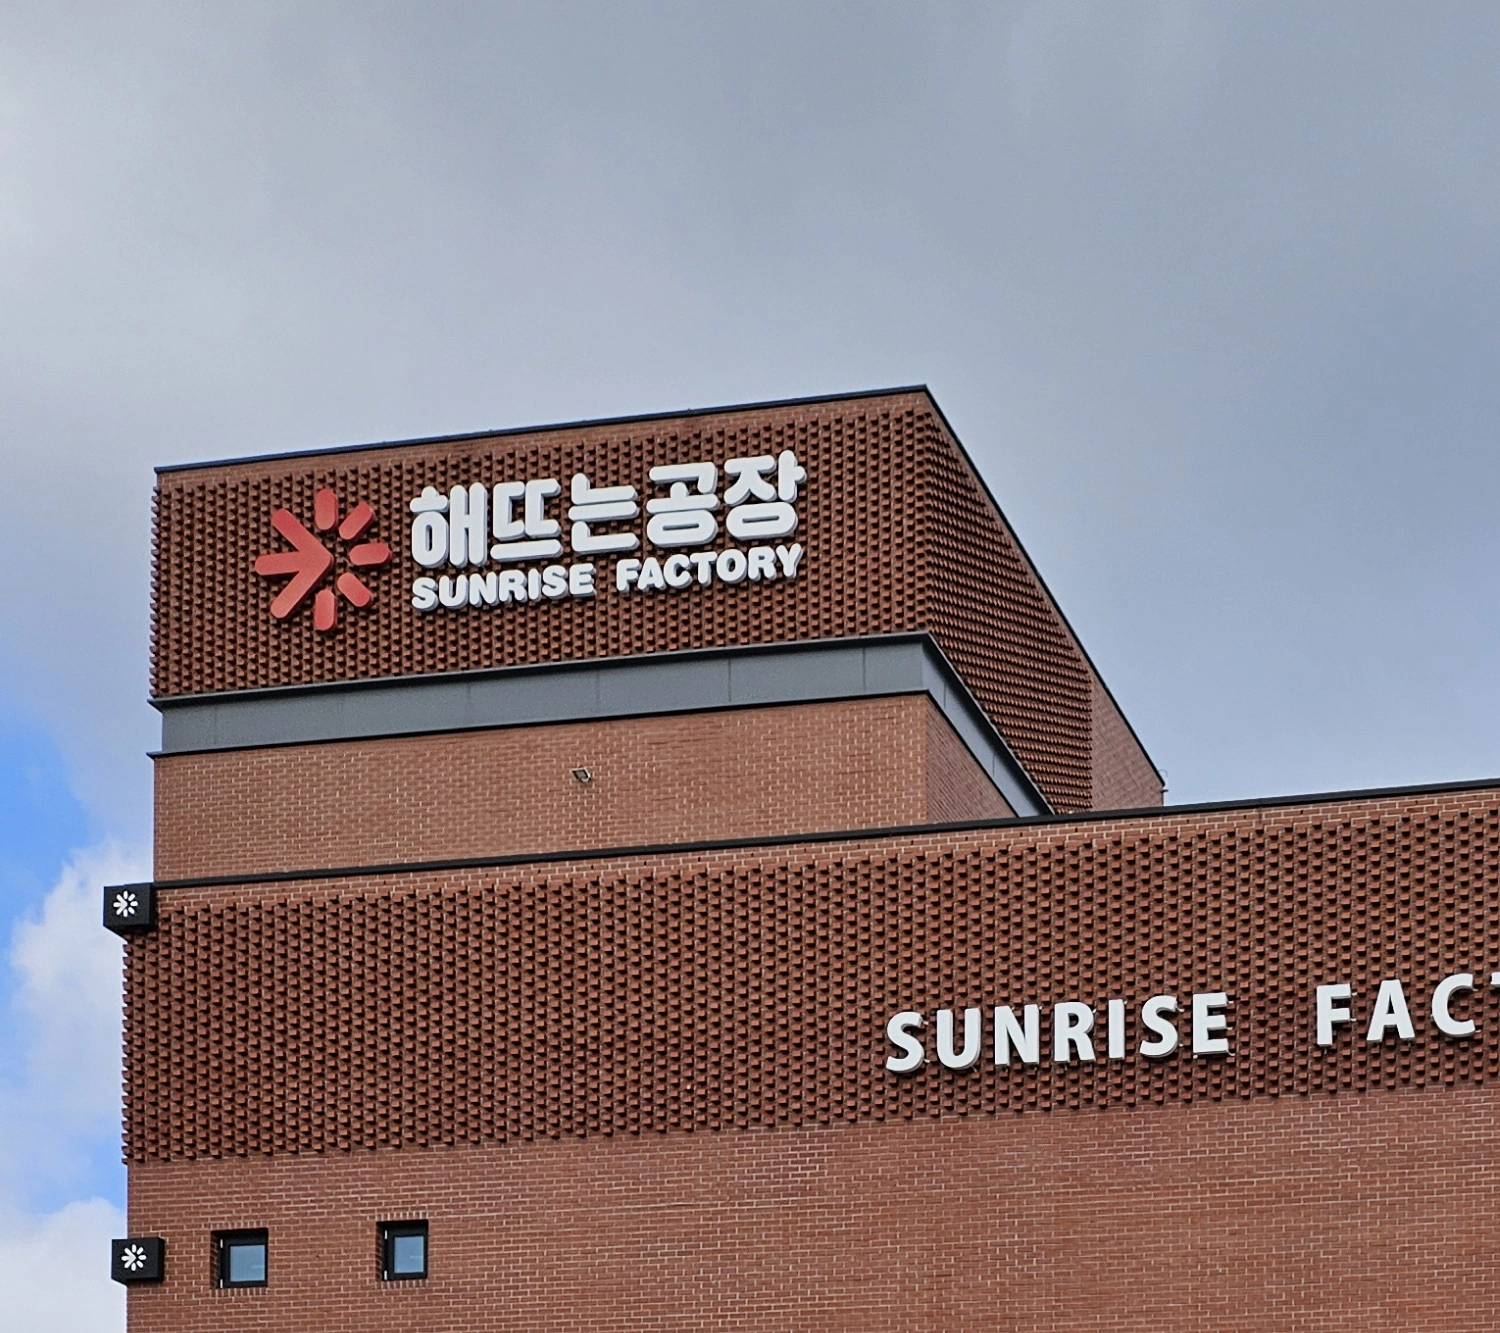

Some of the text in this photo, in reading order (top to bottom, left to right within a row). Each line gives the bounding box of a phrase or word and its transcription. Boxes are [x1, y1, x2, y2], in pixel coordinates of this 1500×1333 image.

[410, 449, 807, 569] 해뜨는공장
[411, 542, 804, 611] SUNRISE FACTORY
[885, 991, 1230, 1073] SUNRISE
